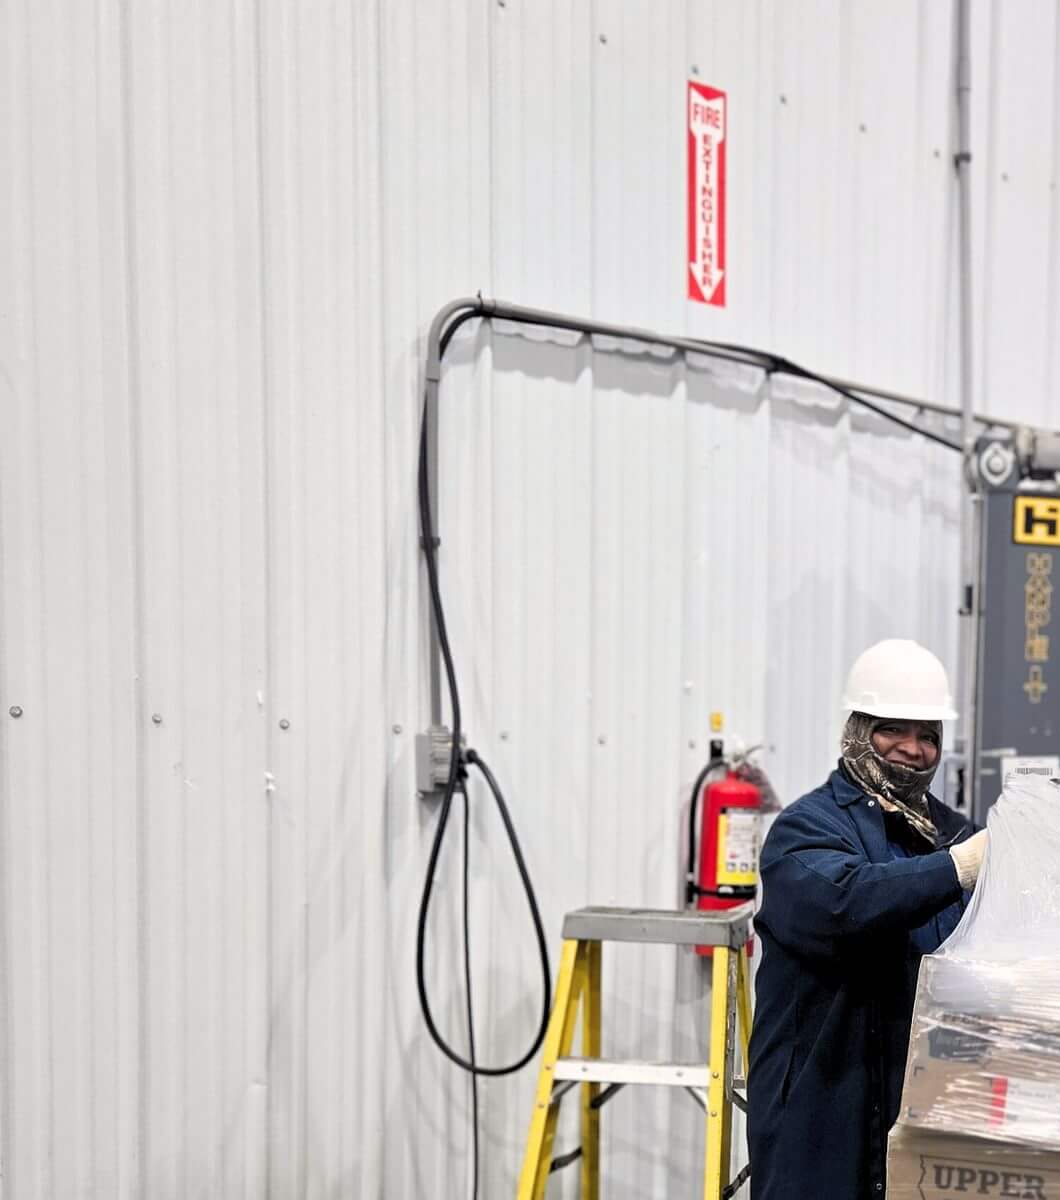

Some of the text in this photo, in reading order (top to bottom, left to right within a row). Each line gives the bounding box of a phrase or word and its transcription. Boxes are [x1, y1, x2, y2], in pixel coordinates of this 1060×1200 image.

[693, 103, 721, 129] FIRE
[701, 134, 713, 287] EXTINGUISHER
[933, 1164, 1046, 1200] UPPER
